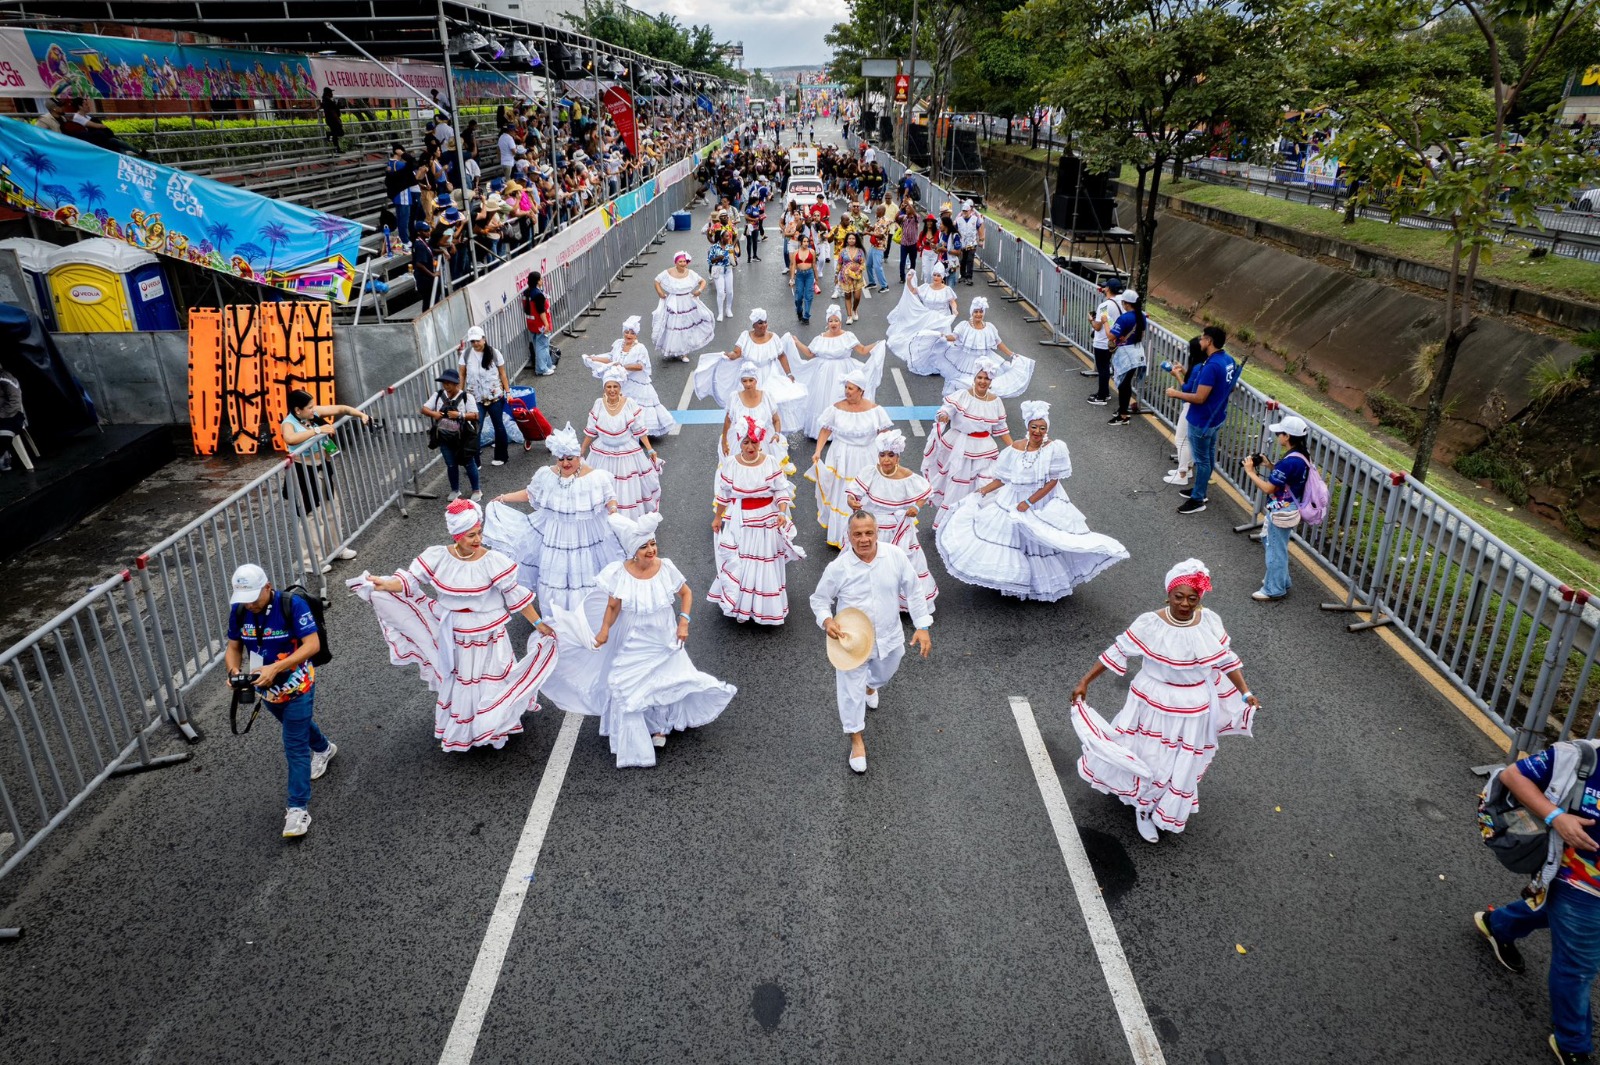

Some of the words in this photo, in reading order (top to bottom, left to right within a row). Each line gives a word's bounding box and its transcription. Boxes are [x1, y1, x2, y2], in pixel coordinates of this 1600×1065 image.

[324, 70, 338, 86] LA
[337, 71, 359, 87] FERIA
[359, 72, 370, 87] DE
[370, 73, 385, 87] CALI
[385, 73, 394, 88] ES
[414, 74, 430, 88] DEBES
[119, 159, 157, 181] DEBES
[167, 172, 194, 192] 67
[166, 185, 199, 206] Feria
[172, 199, 204, 218] Cali
